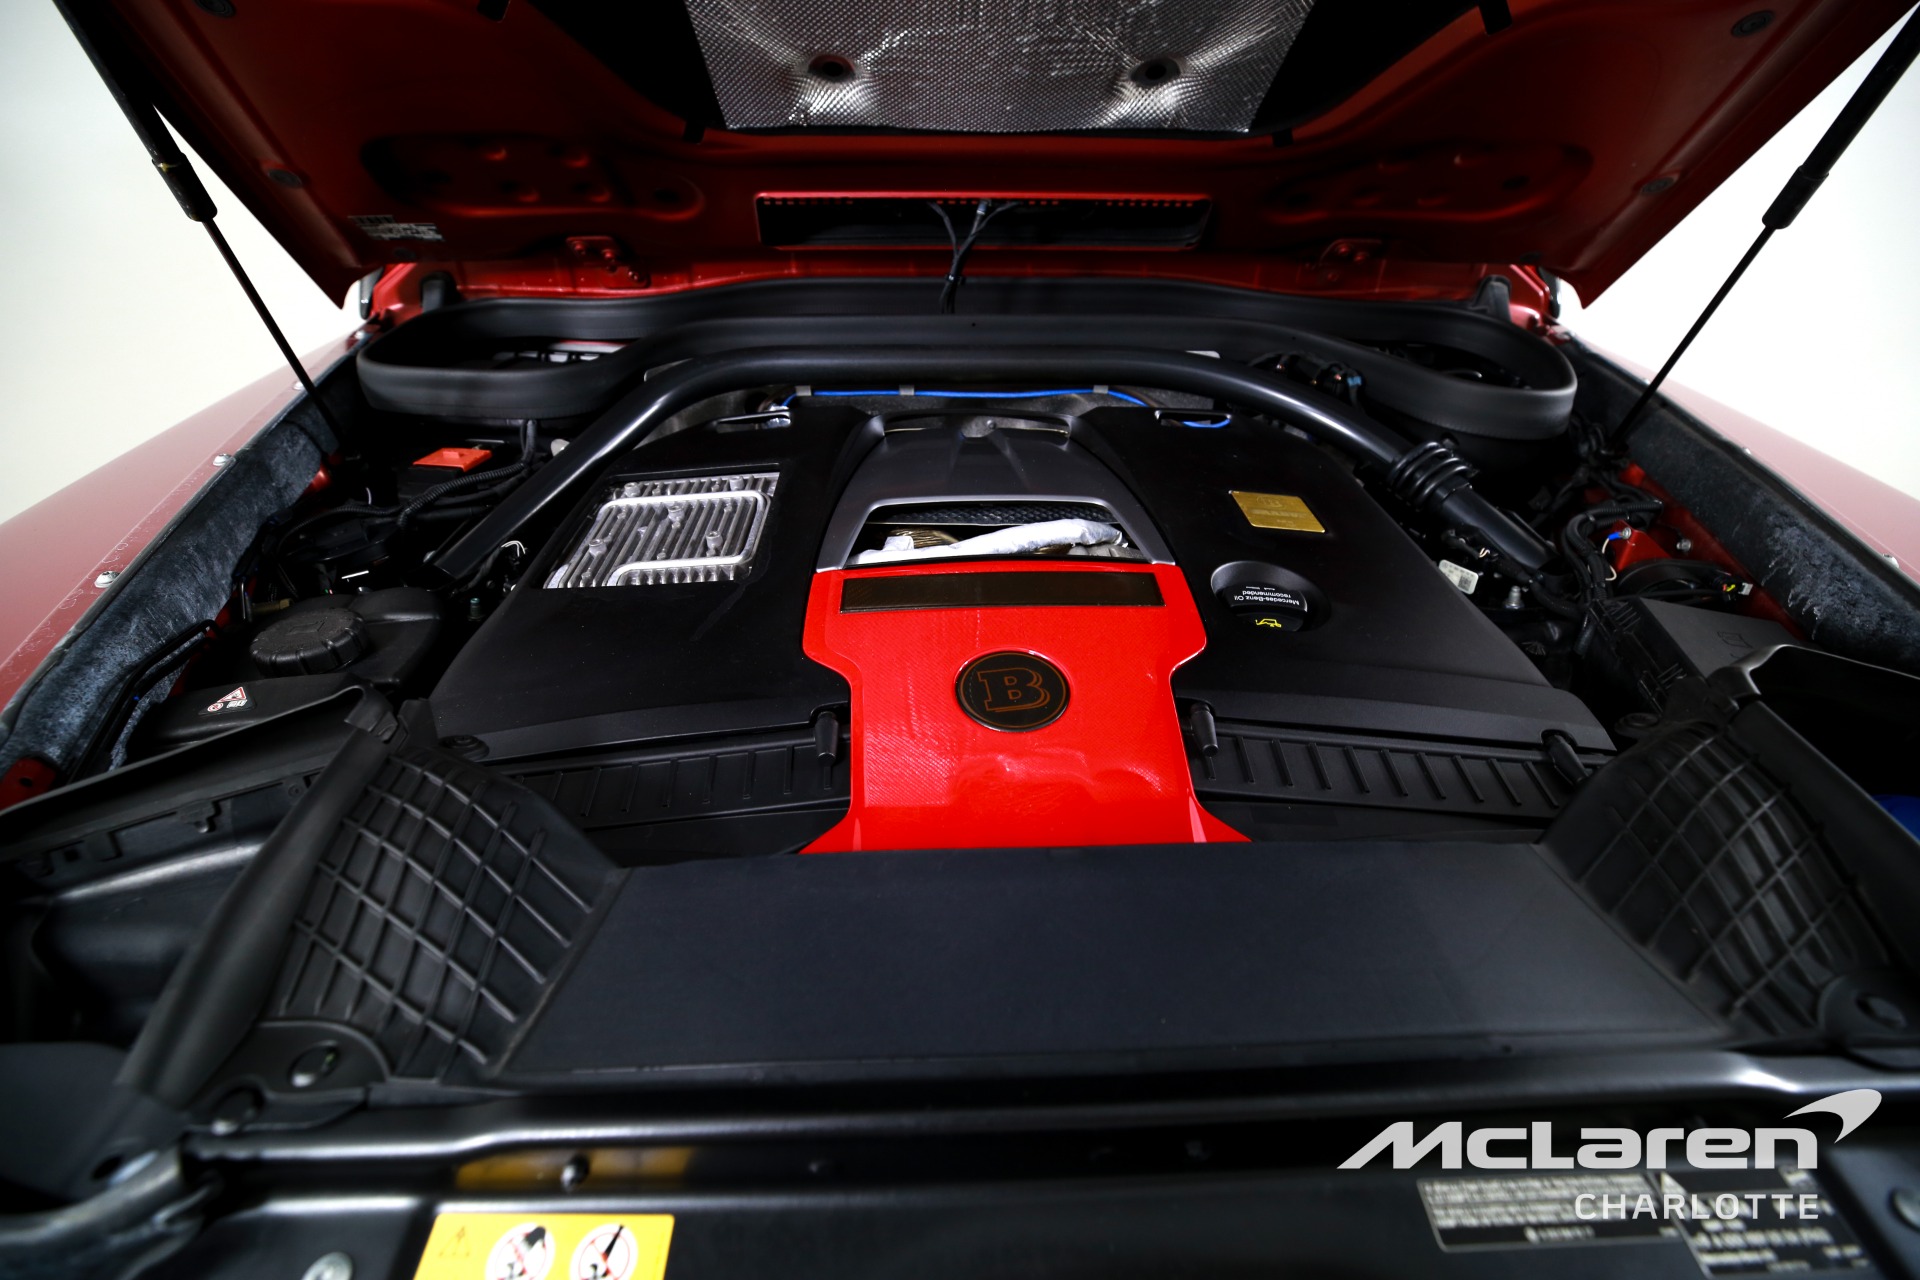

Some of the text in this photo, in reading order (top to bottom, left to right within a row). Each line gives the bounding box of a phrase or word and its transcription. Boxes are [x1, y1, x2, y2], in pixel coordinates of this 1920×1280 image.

[1242, 590, 1292, 598] recommended
[1245, 595, 1300, 606] Mercedes-Benz
[977, 667, 1051, 712] B
